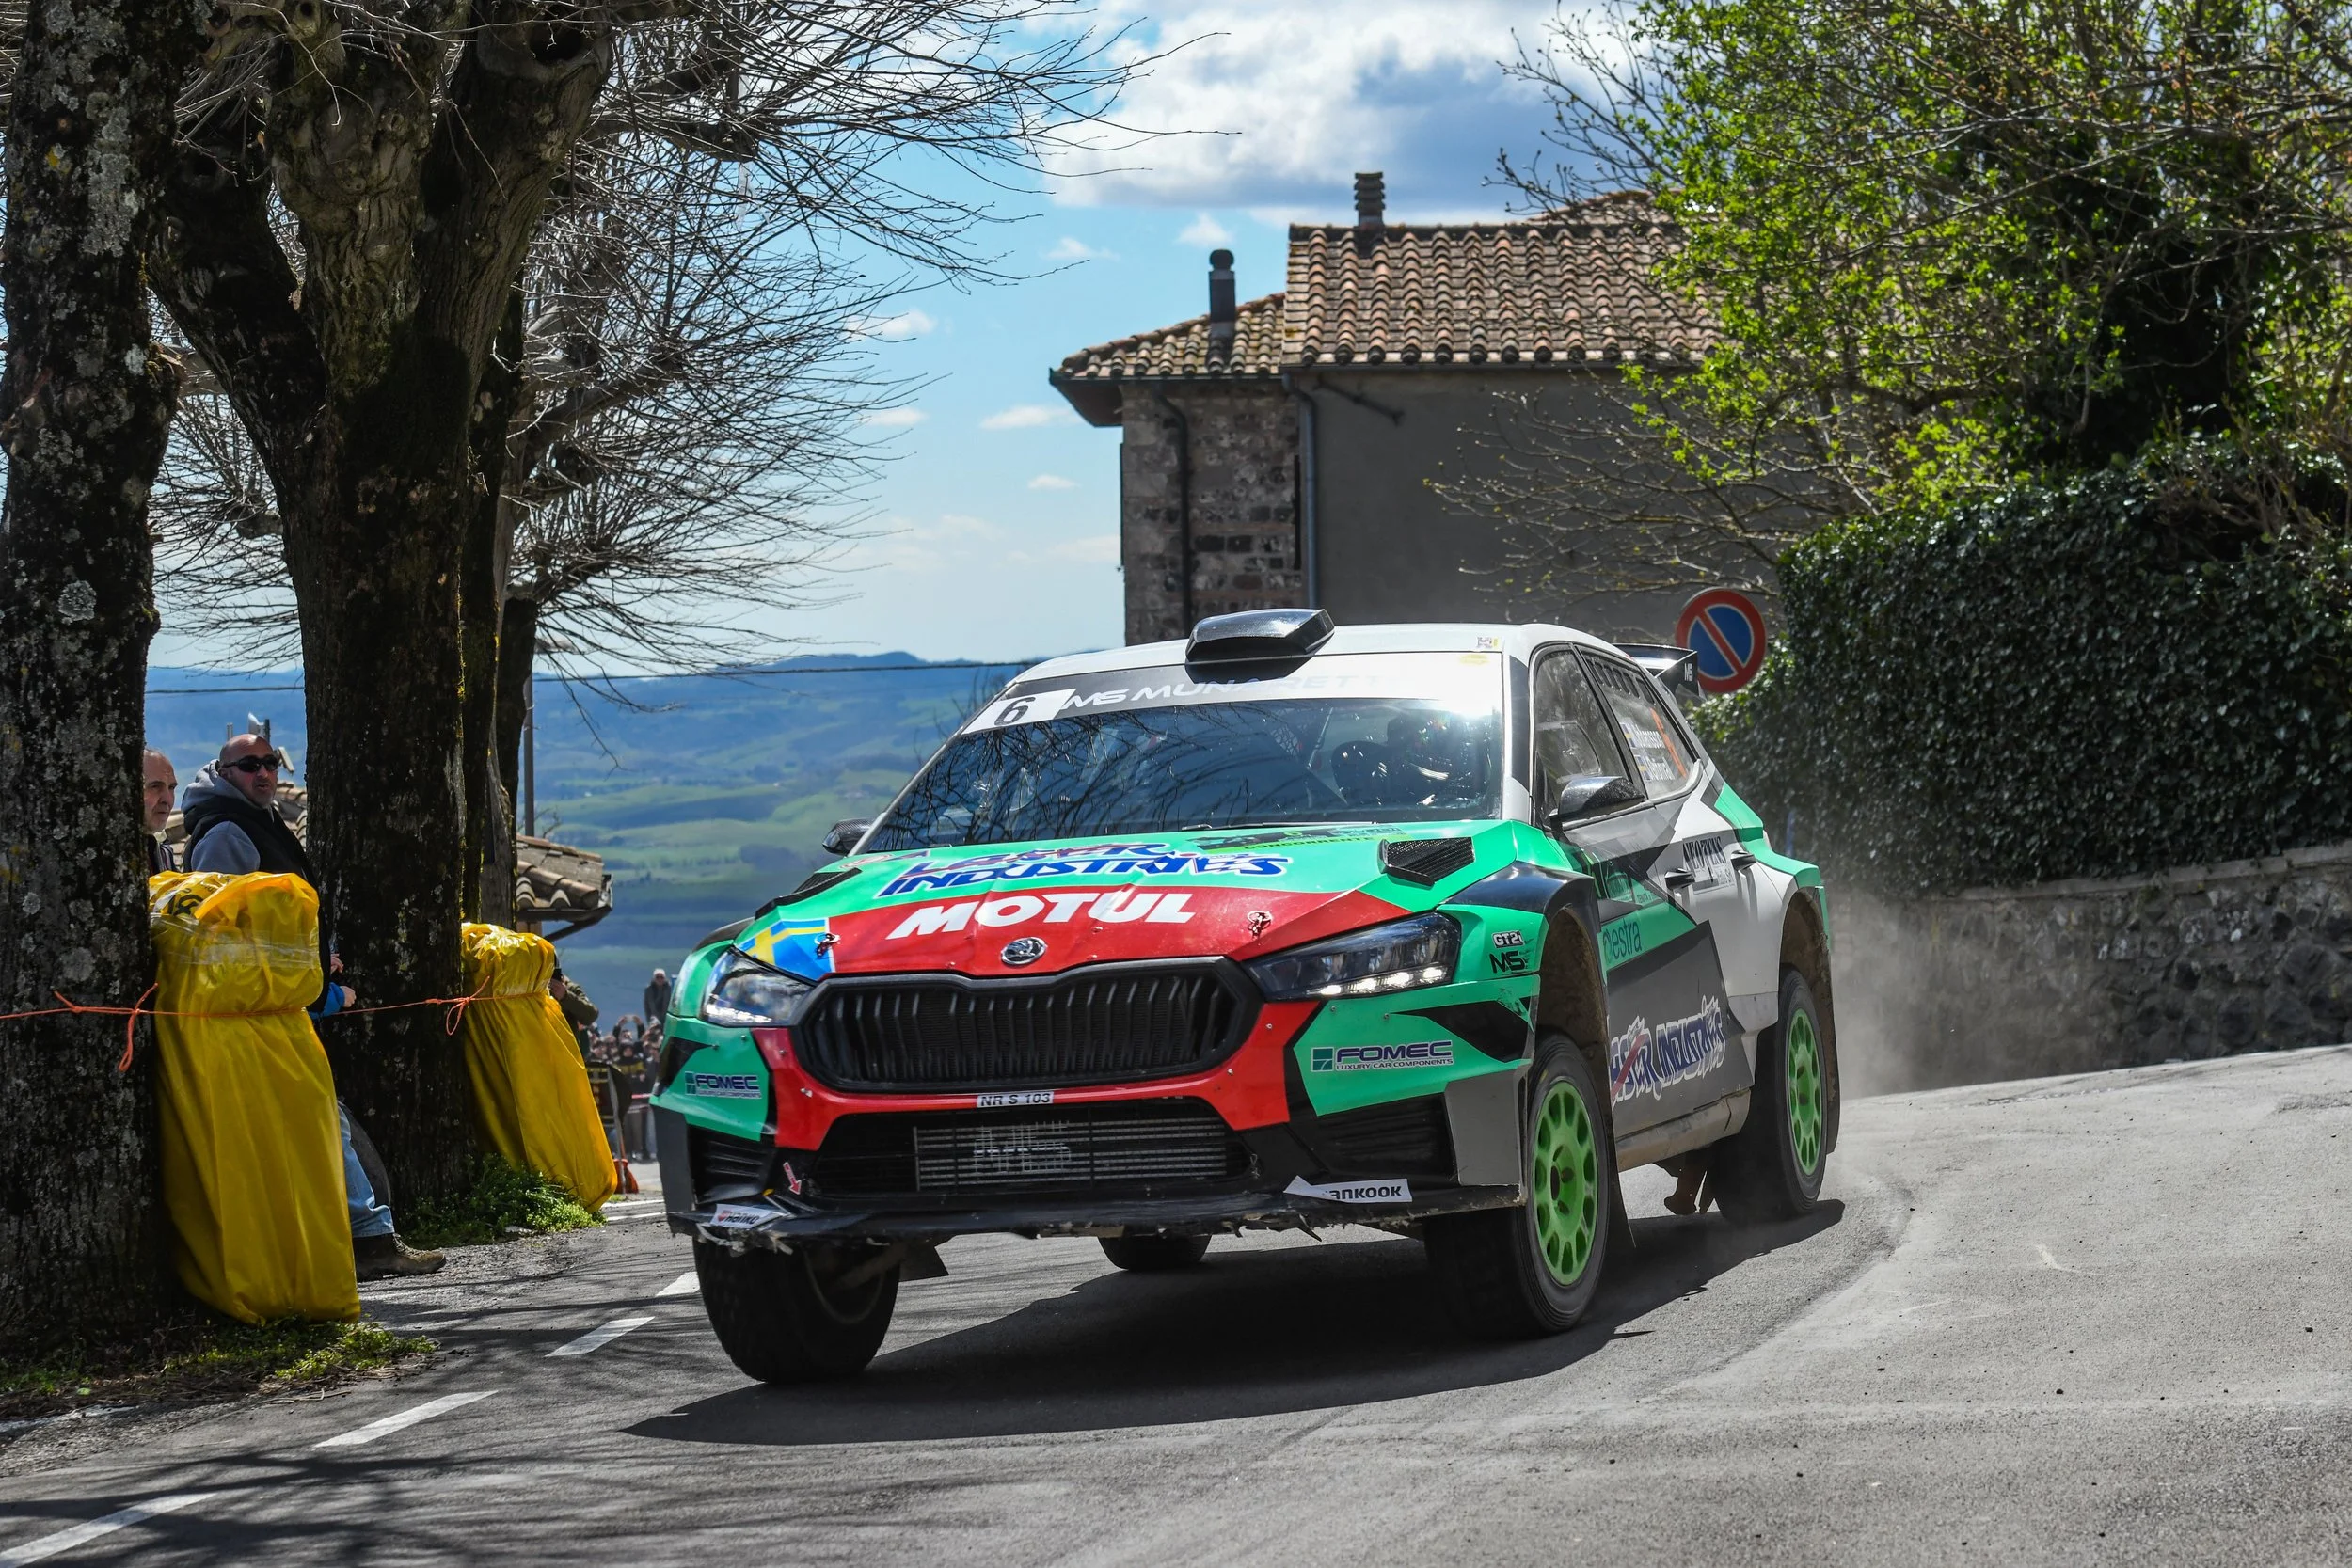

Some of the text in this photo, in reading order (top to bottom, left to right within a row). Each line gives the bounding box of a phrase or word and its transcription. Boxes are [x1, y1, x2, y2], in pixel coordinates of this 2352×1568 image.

[1062, 674, 1387, 710] MS MUNARETT
[994, 697, 1036, 726] 6
[884, 893, 1196, 940] MOTUL
[1489, 950, 1526, 974] MS
[1337, 1040, 1452, 1063] FOMEC
[696, 1074, 759, 1090] FOMEC
[981, 1093, 1051, 1107] NR S 103
